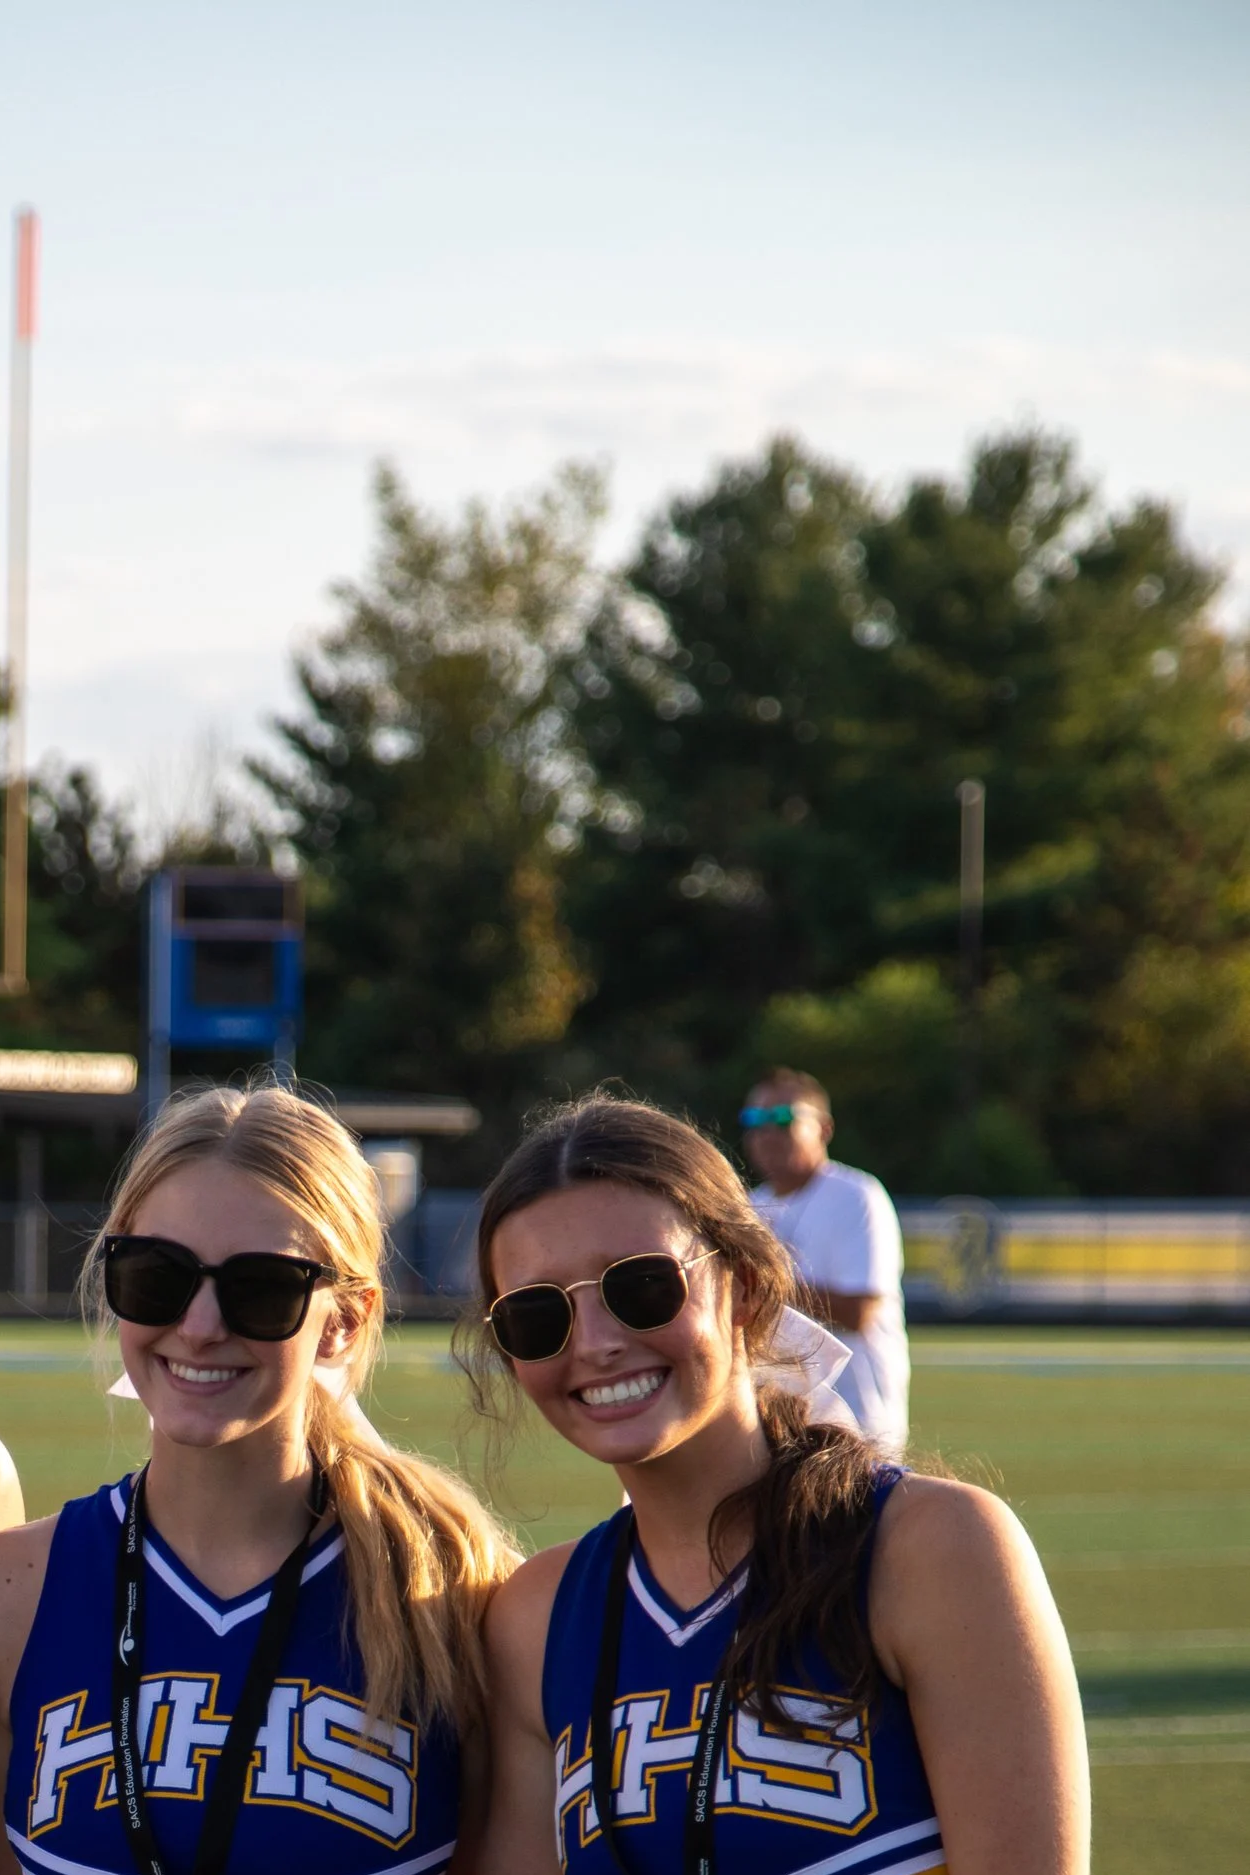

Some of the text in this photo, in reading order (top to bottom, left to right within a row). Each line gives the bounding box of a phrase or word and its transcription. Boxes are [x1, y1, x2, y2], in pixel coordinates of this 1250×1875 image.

[127, 1524, 136, 1553] SACS
[27, 1671, 419, 1851] HHS
[120, 1697, 141, 1829] SACS Education Foundation
[554, 1682, 879, 1875] HHS
[695, 1680, 726, 1823] SACS Education Foundation
